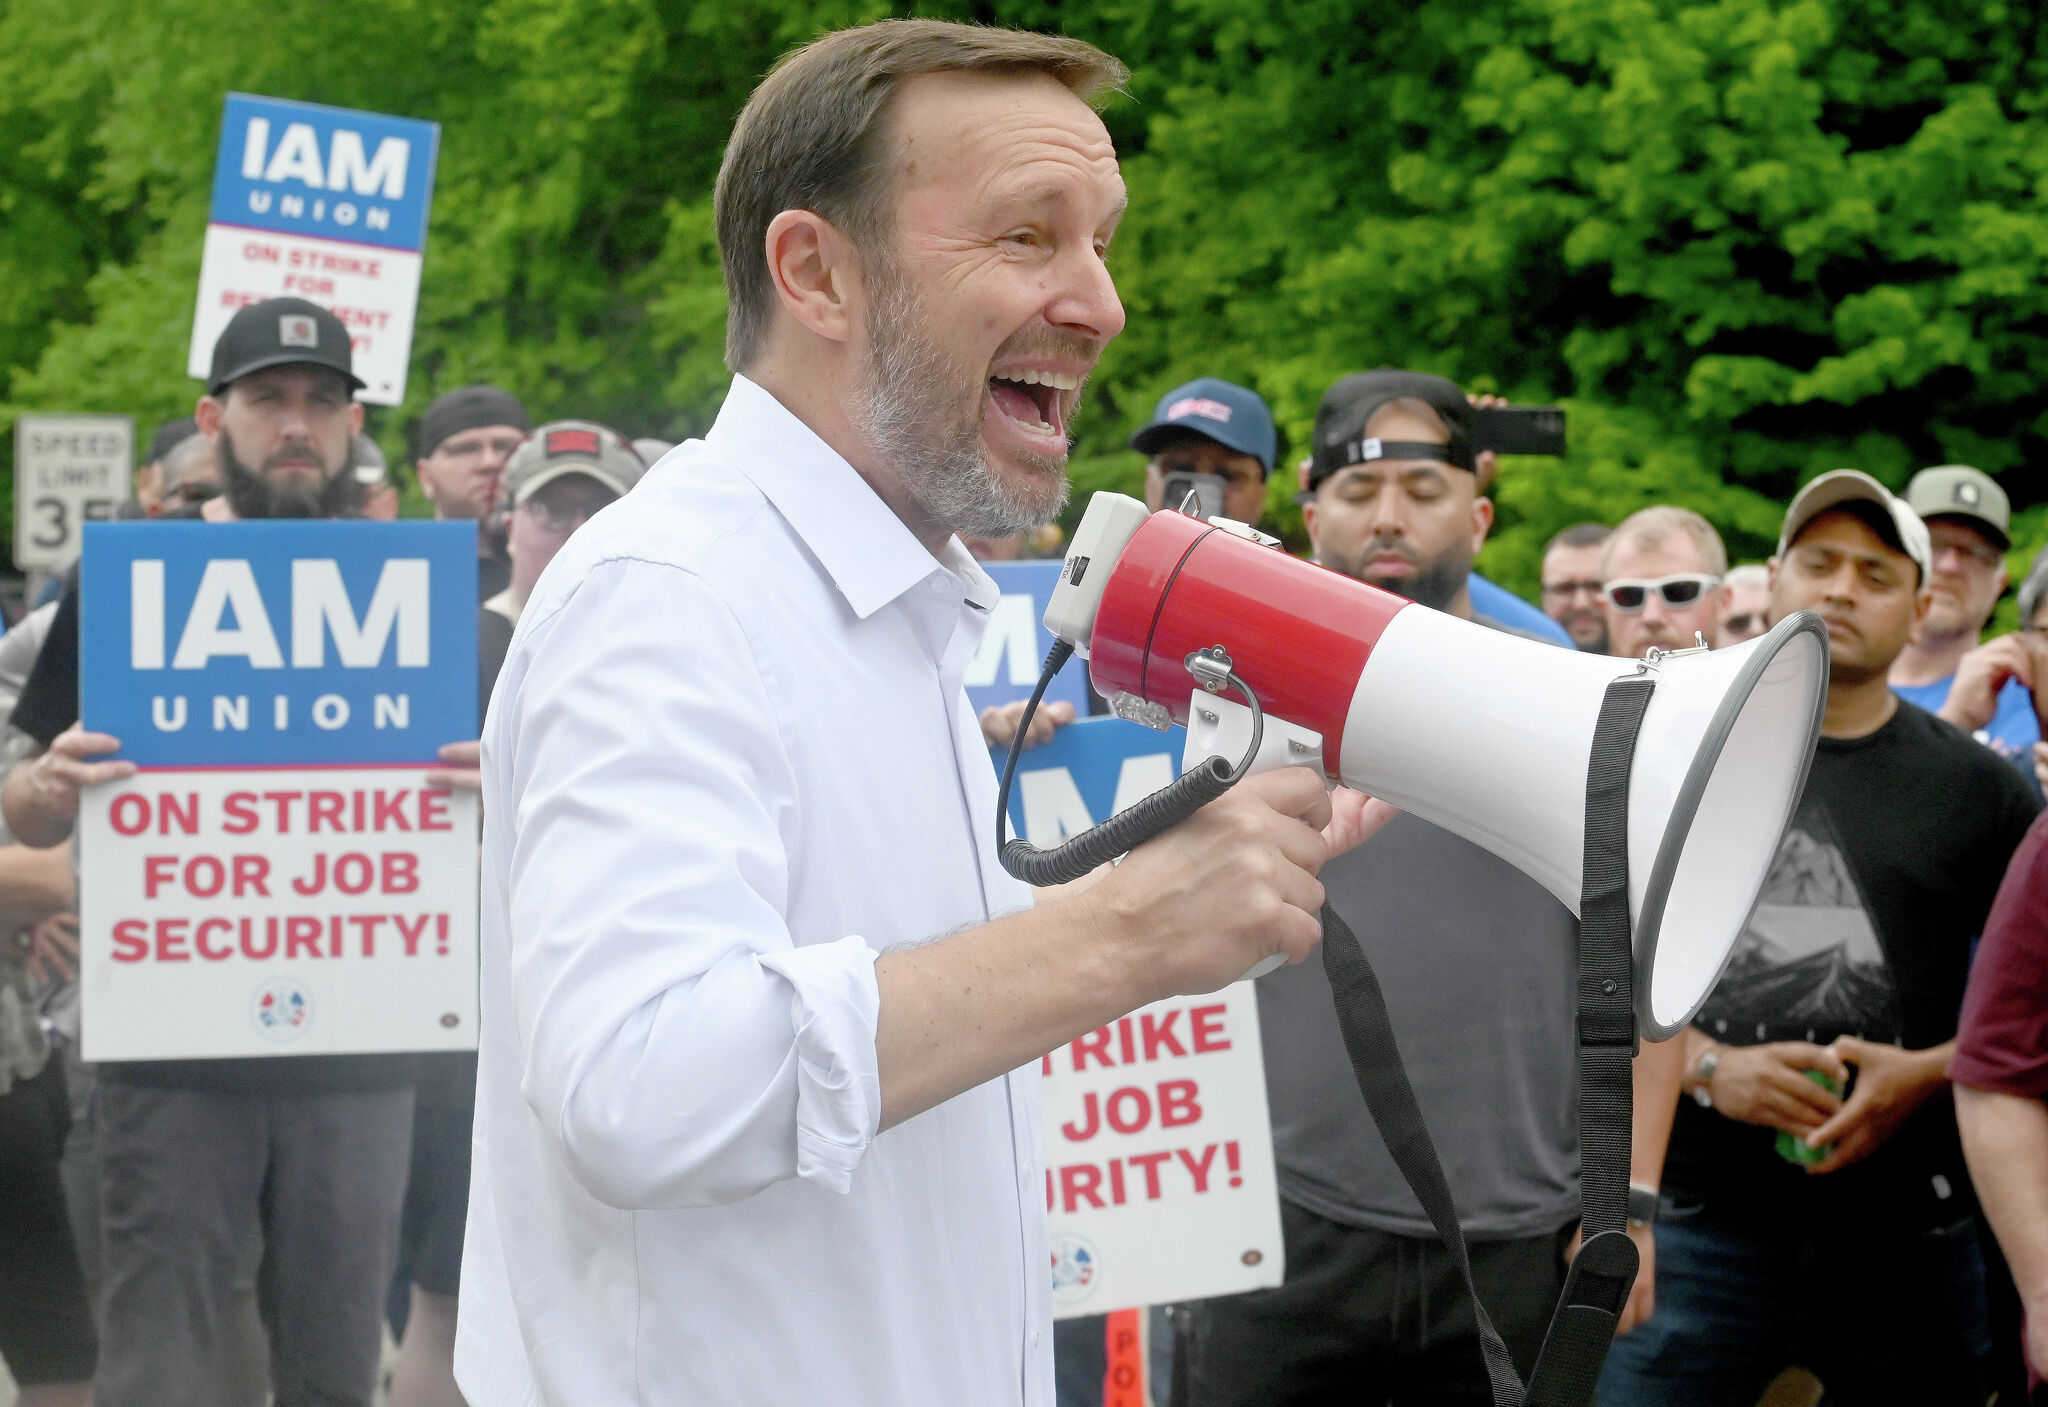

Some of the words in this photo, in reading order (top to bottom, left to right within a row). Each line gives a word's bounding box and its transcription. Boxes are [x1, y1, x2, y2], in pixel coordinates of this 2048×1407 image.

[242, 117, 410, 201] IAM
[249, 190, 391, 231] UNION
[243, 243, 280, 264] ON
[288, 249, 381, 280] STRIKE
[284, 273, 336, 295] FOR
[32, 433, 121, 457] SPEED
[37, 464, 110, 487] LIMIT
[1061, 557, 1075, 579] VOLUME
[131, 559, 430, 670] IAM
[152, 694, 410, 732] UNION
[109, 792, 199, 837] ON
[222, 789, 454, 835] STRIKE
[144, 854, 272, 900] FOR
[292, 852, 420, 896] JOB
[110, 913, 451, 962] SECURITY!
[1042, 1004, 1231, 1076] RIKE
[1061, 1079, 1204, 1143] JOB
[1046, 1140, 1244, 1214] RITY!
